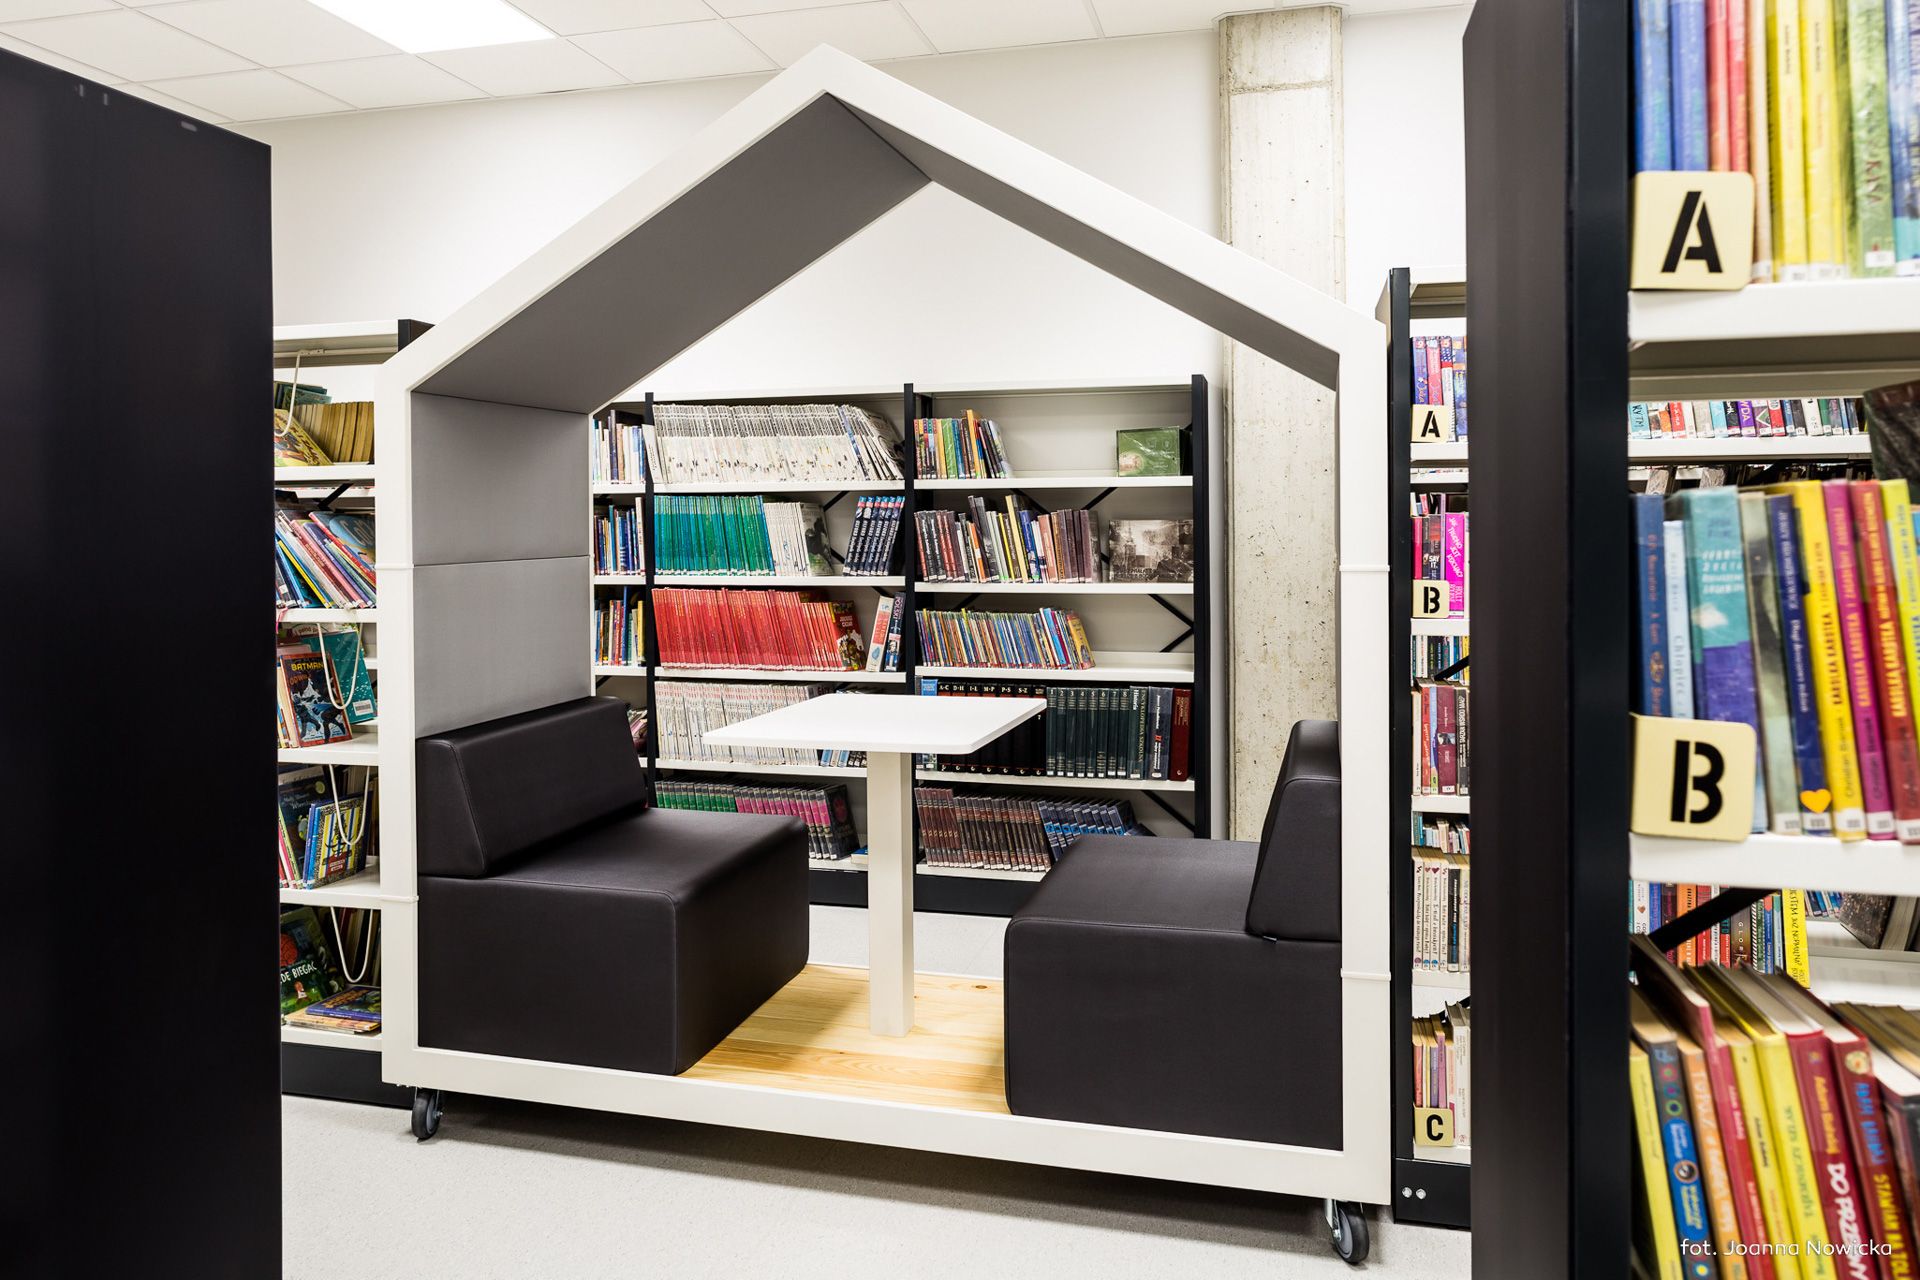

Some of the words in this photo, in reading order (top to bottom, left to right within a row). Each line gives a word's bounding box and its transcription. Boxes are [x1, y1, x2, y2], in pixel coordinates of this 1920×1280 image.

[1661, 190, 1723, 273] A
[1421, 410, 1441, 438] A
[1423, 586, 1440, 614] B
[1820, 611, 1837, 657] KAROTKA
[1846, 612, 1864, 659] KAROTKA
[291, 662, 324, 671] BATMAN
[1827, 659, 1843, 705] KAROLKA
[1853, 660, 1870, 707] KAROLKA
[1670, 740, 1724, 824] B
[1426, 1114, 1443, 1141] C
[1827, 1161, 1850, 1196] DO
